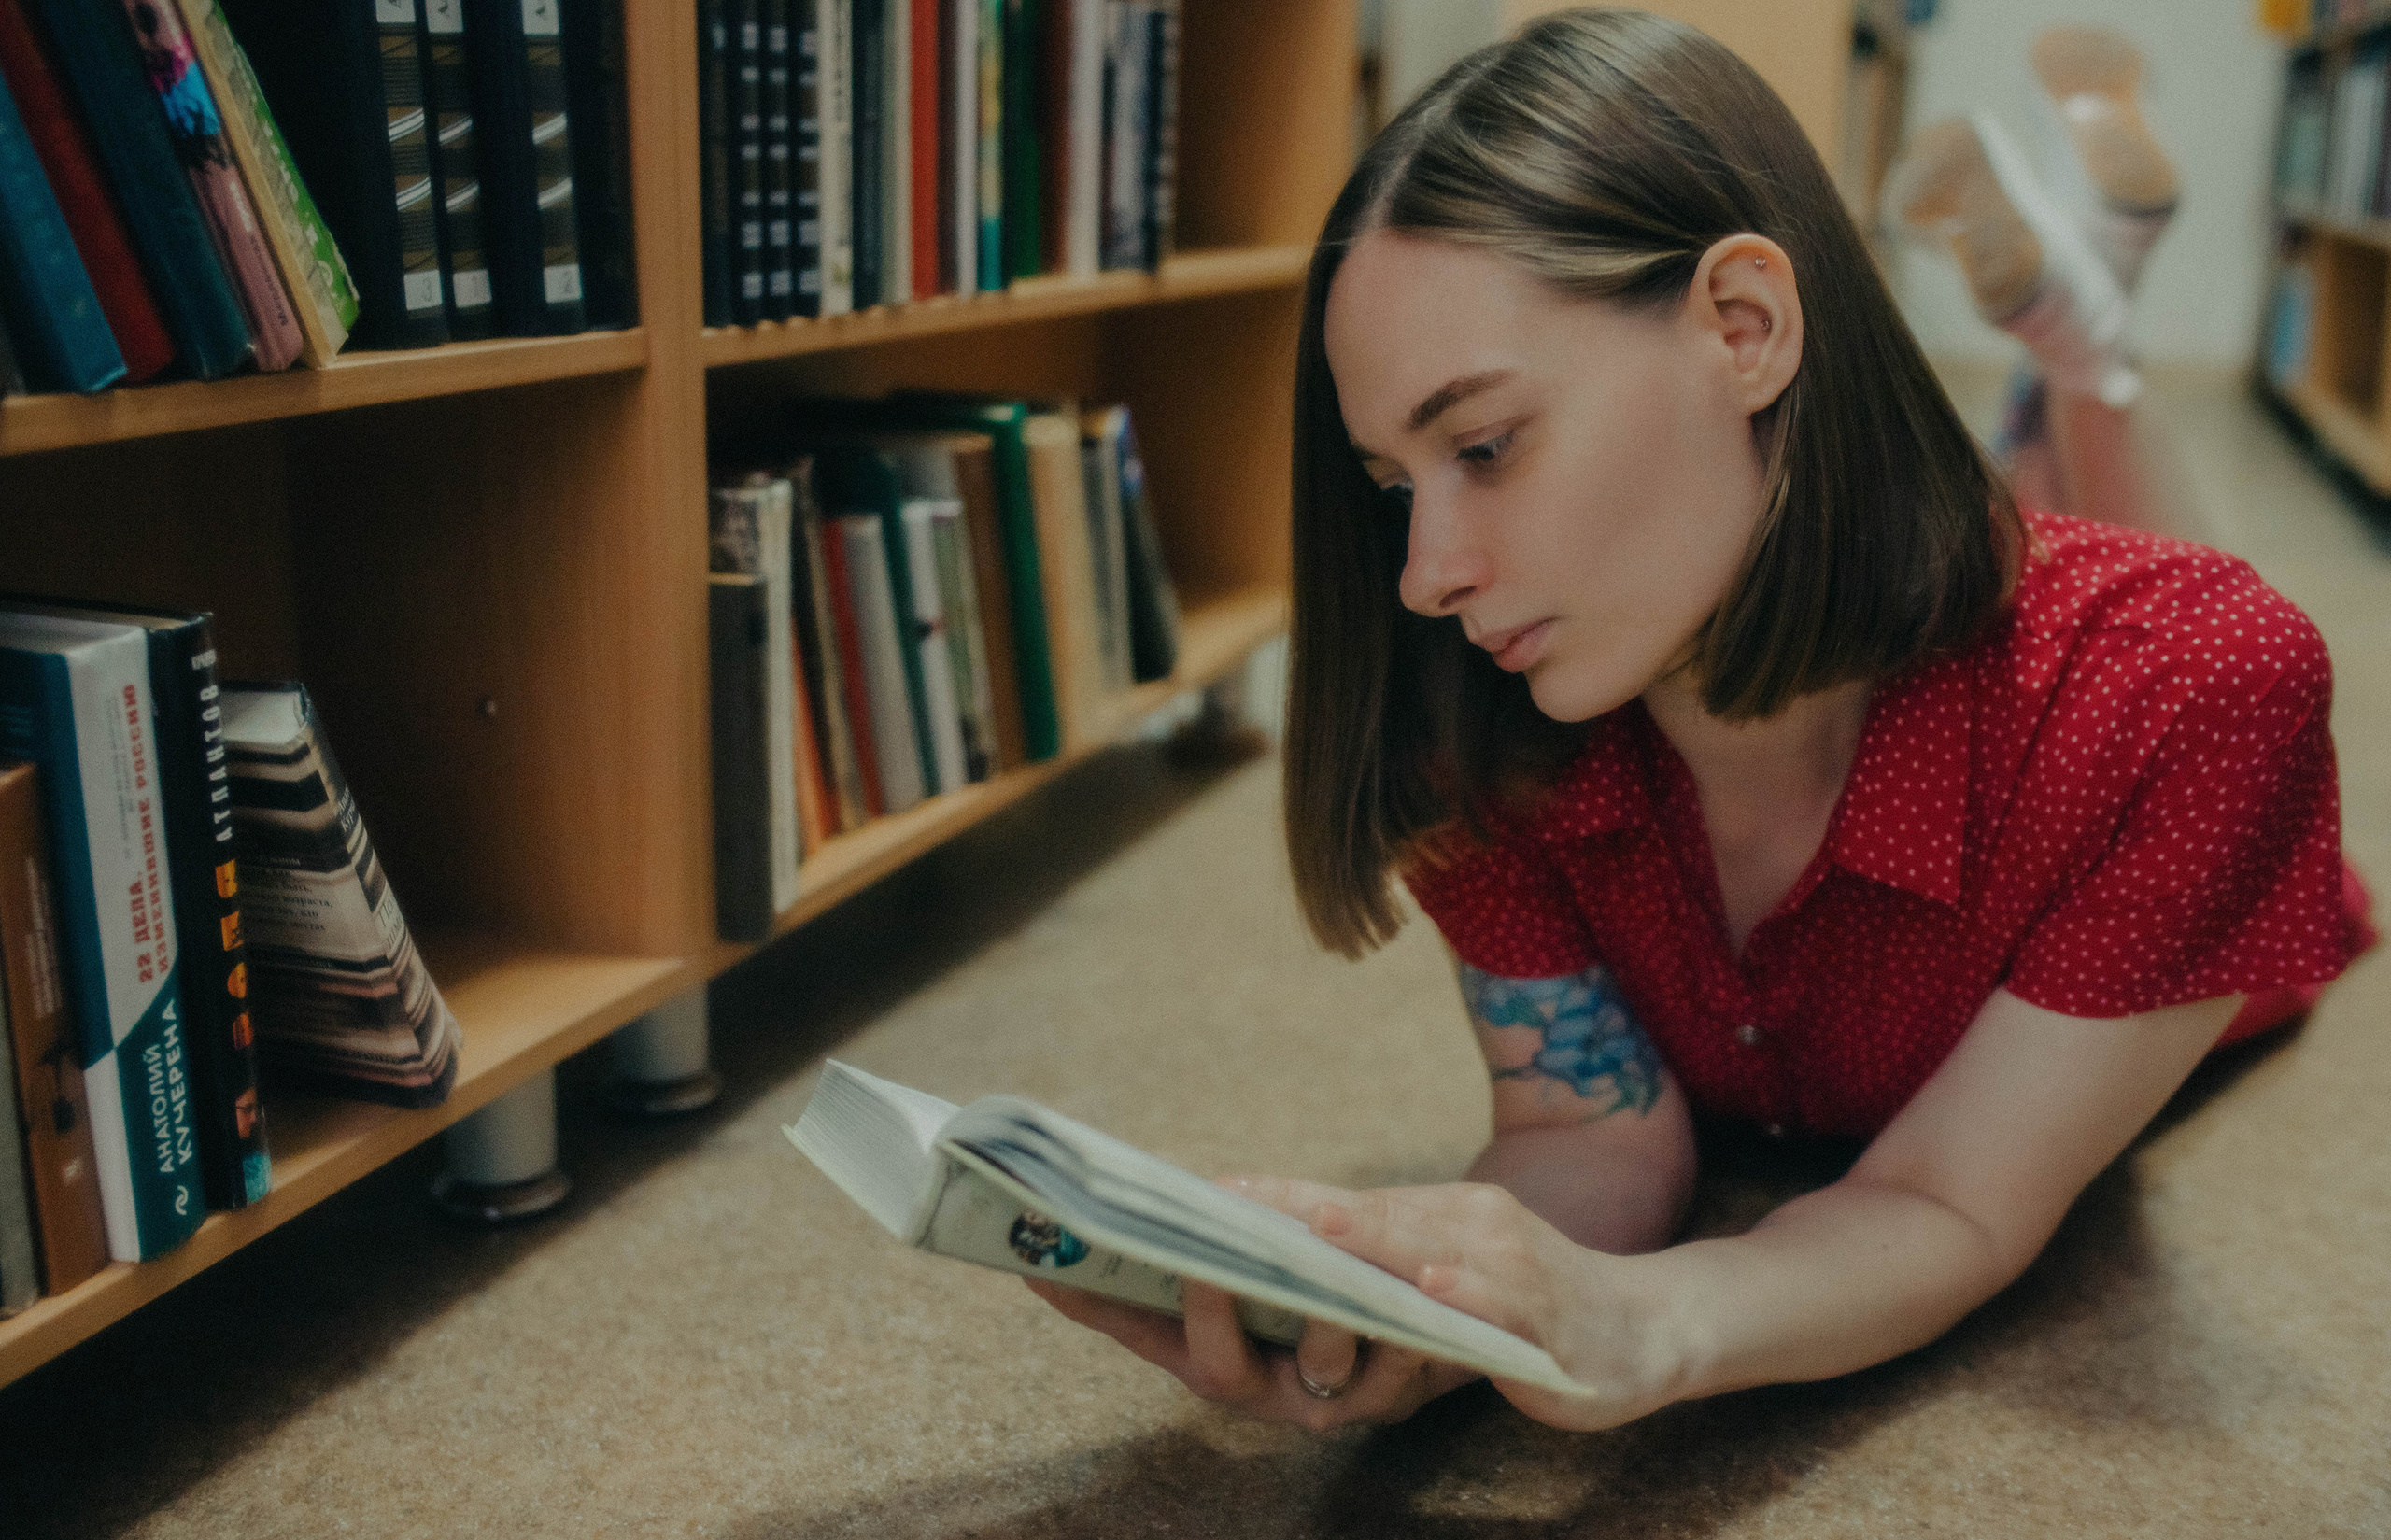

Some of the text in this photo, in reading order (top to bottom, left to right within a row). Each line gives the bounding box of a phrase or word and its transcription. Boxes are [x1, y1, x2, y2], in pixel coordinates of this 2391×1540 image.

[123, 684, 169, 974] ИЗМЕНИВШИЕ РОССИЮ
[199, 685, 233, 842] АТЛАНТОВ
[137, 952, 153, 983] 22
[142, 1043, 175, 1173] АНАТОЛИЙ
[162, 998, 192, 1166] КУЧЕРЕНА
